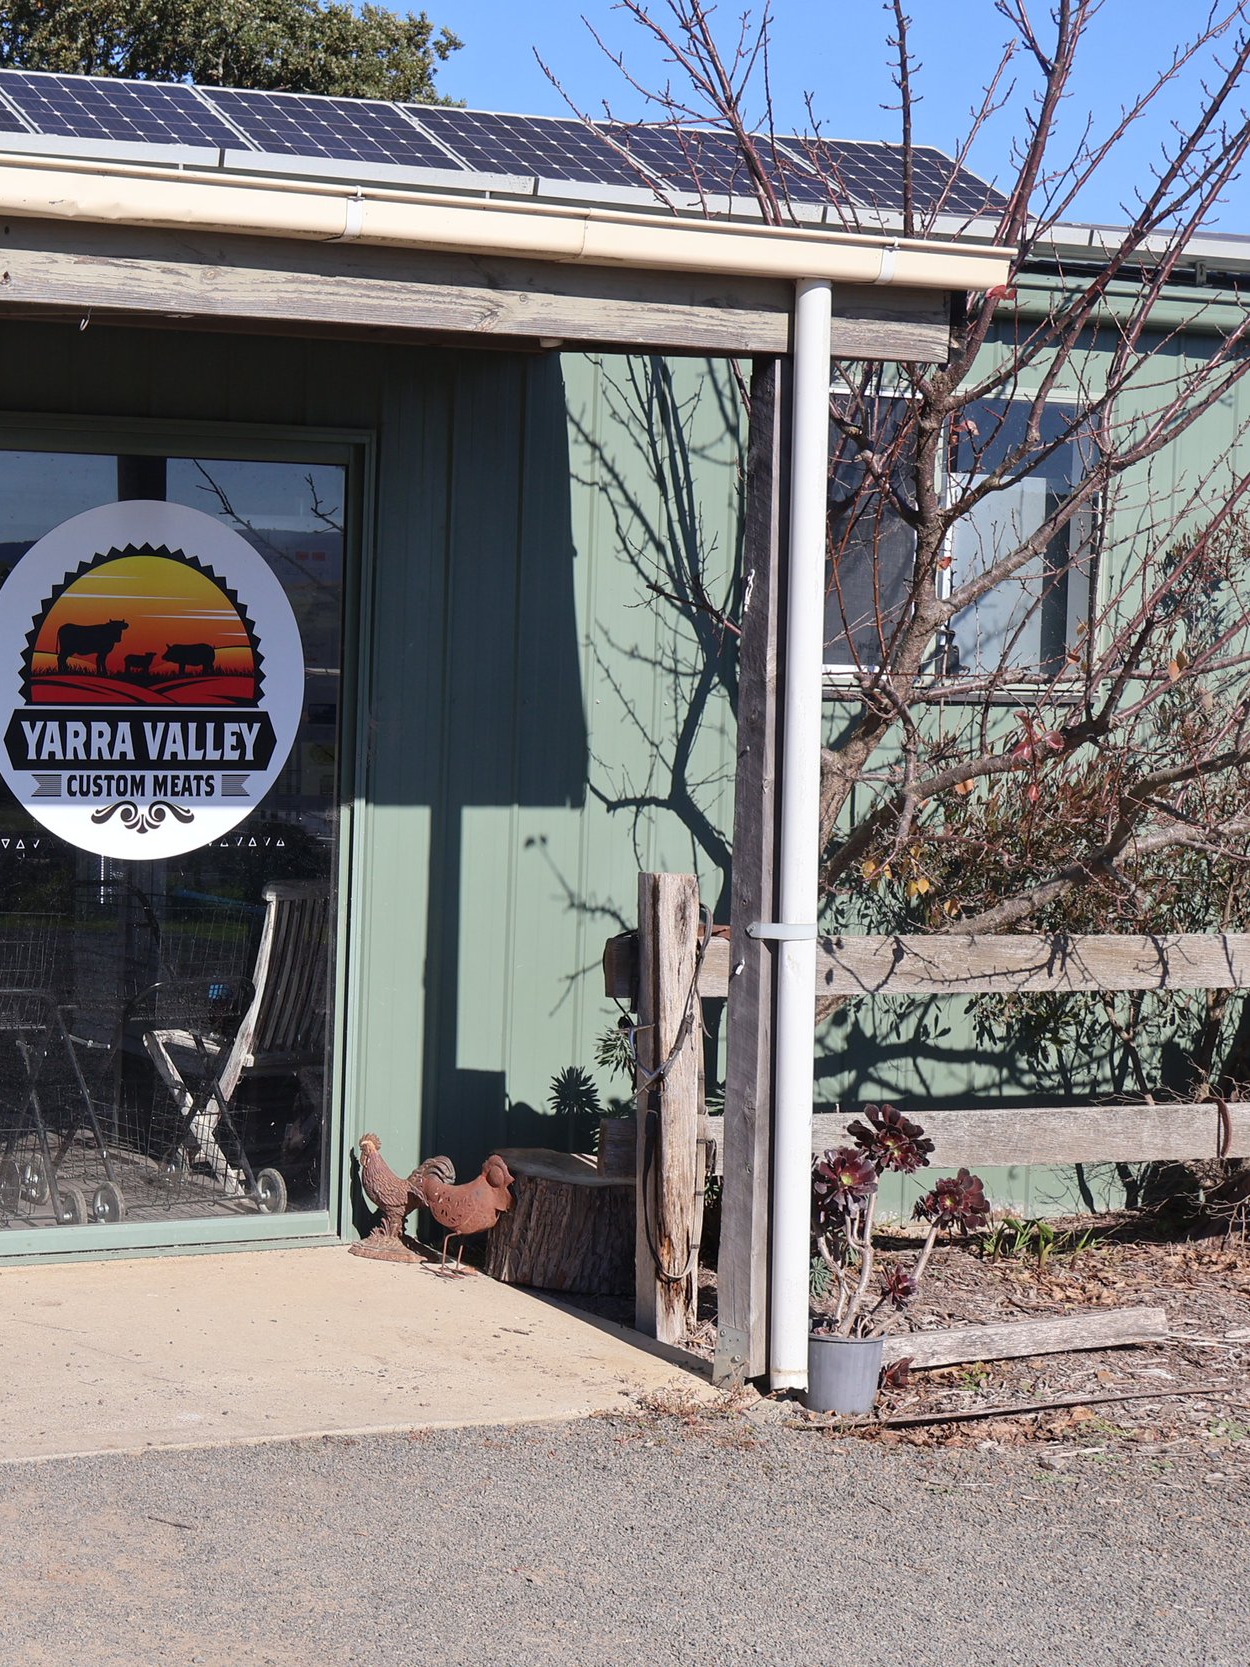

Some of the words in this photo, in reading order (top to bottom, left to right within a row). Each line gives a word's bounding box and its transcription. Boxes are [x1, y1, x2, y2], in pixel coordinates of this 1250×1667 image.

[20, 720, 136, 761] YARRA
[143, 721, 262, 761] VALLEY
[66, 774, 146, 797] CUSTOM
[152, 773, 216, 797] MEATS
